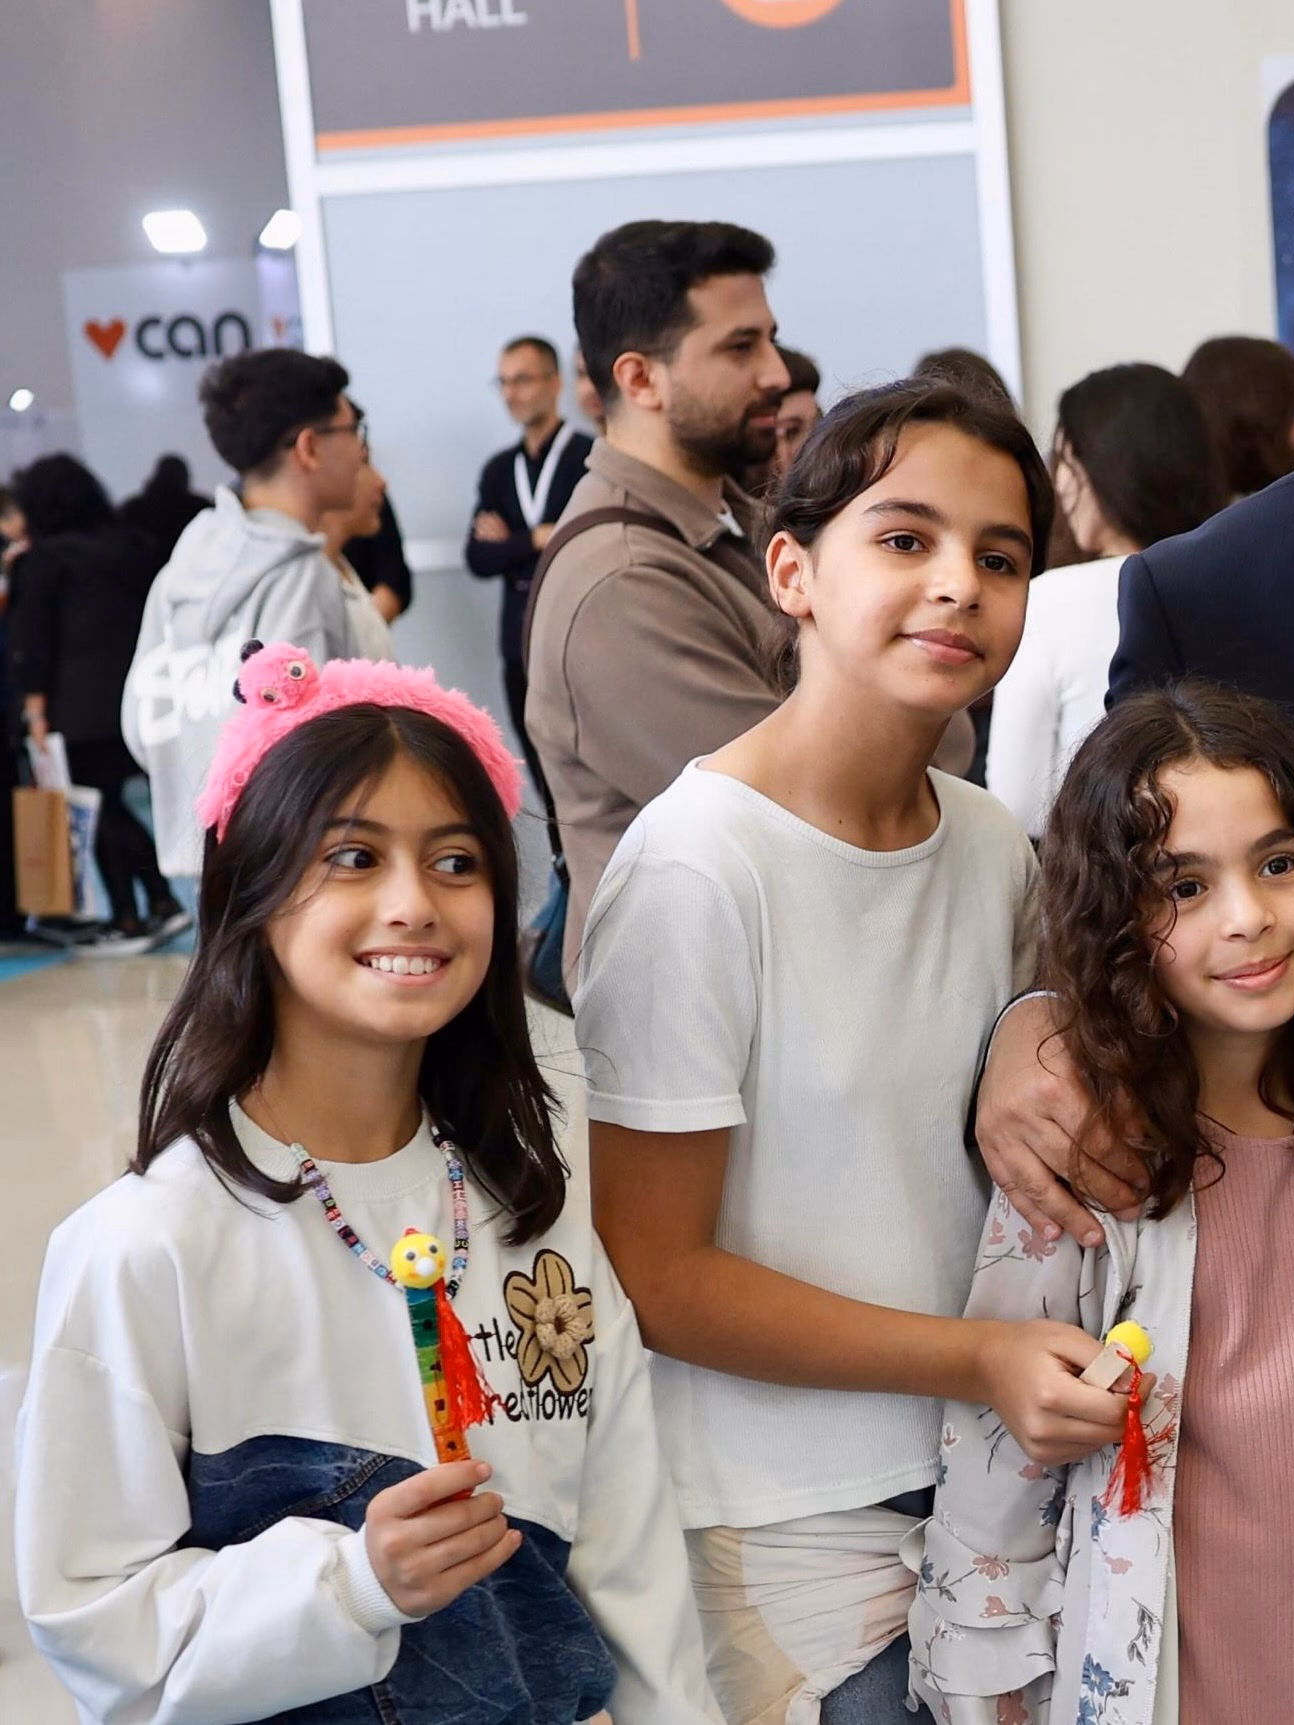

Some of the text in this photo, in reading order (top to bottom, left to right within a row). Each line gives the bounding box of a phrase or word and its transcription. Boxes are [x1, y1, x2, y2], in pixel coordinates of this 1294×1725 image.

[406, 0, 528, 33] HALL
[135, 312, 250, 360] can
[473, 1316, 519, 1362] tle
